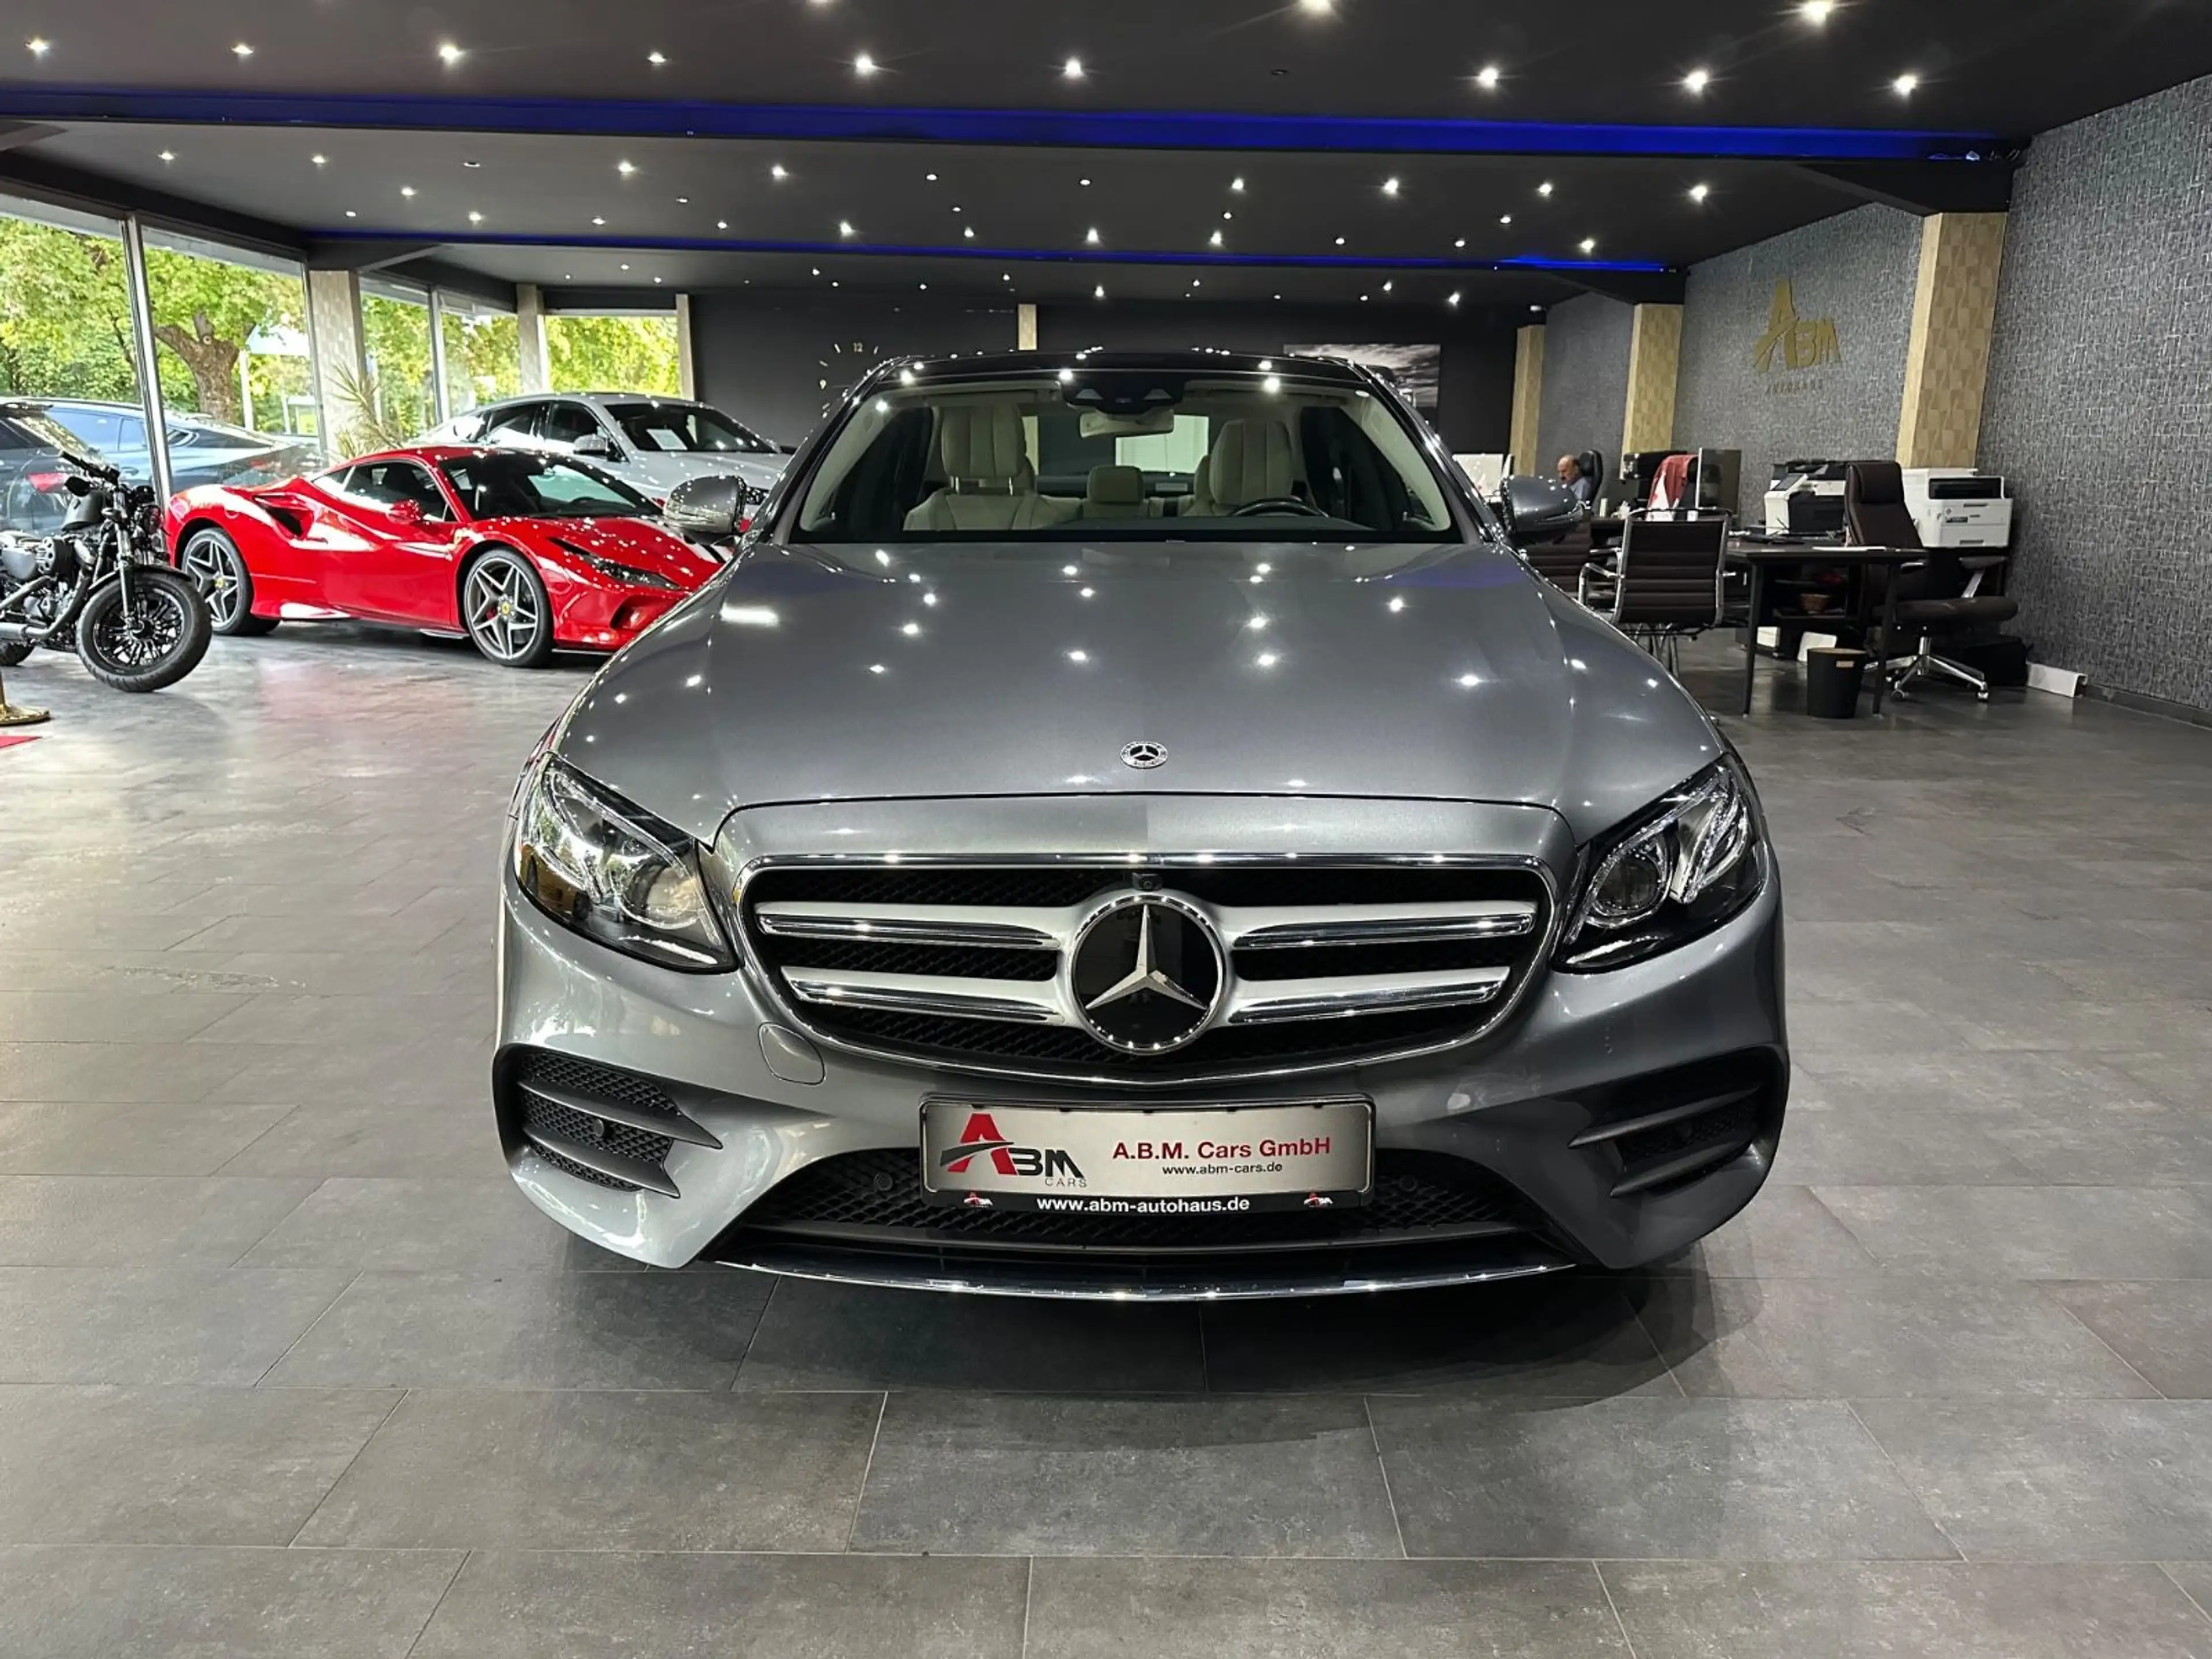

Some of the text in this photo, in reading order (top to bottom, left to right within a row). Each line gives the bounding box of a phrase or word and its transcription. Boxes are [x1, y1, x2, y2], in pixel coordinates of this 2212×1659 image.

[1753, 276, 1840, 373] ABM
[853, 342, 863, 353] 12
[941, 1113, 1085, 1177] ABM
[1112, 1137, 1331, 1160] A.B.M. Cars GmbH
[1162, 1161, 1283, 1176] www.abm-cars.de
[1044, 1176, 1088, 1189] CARS
[1036, 1196, 1251, 1213] www.abm-autohaus.de
